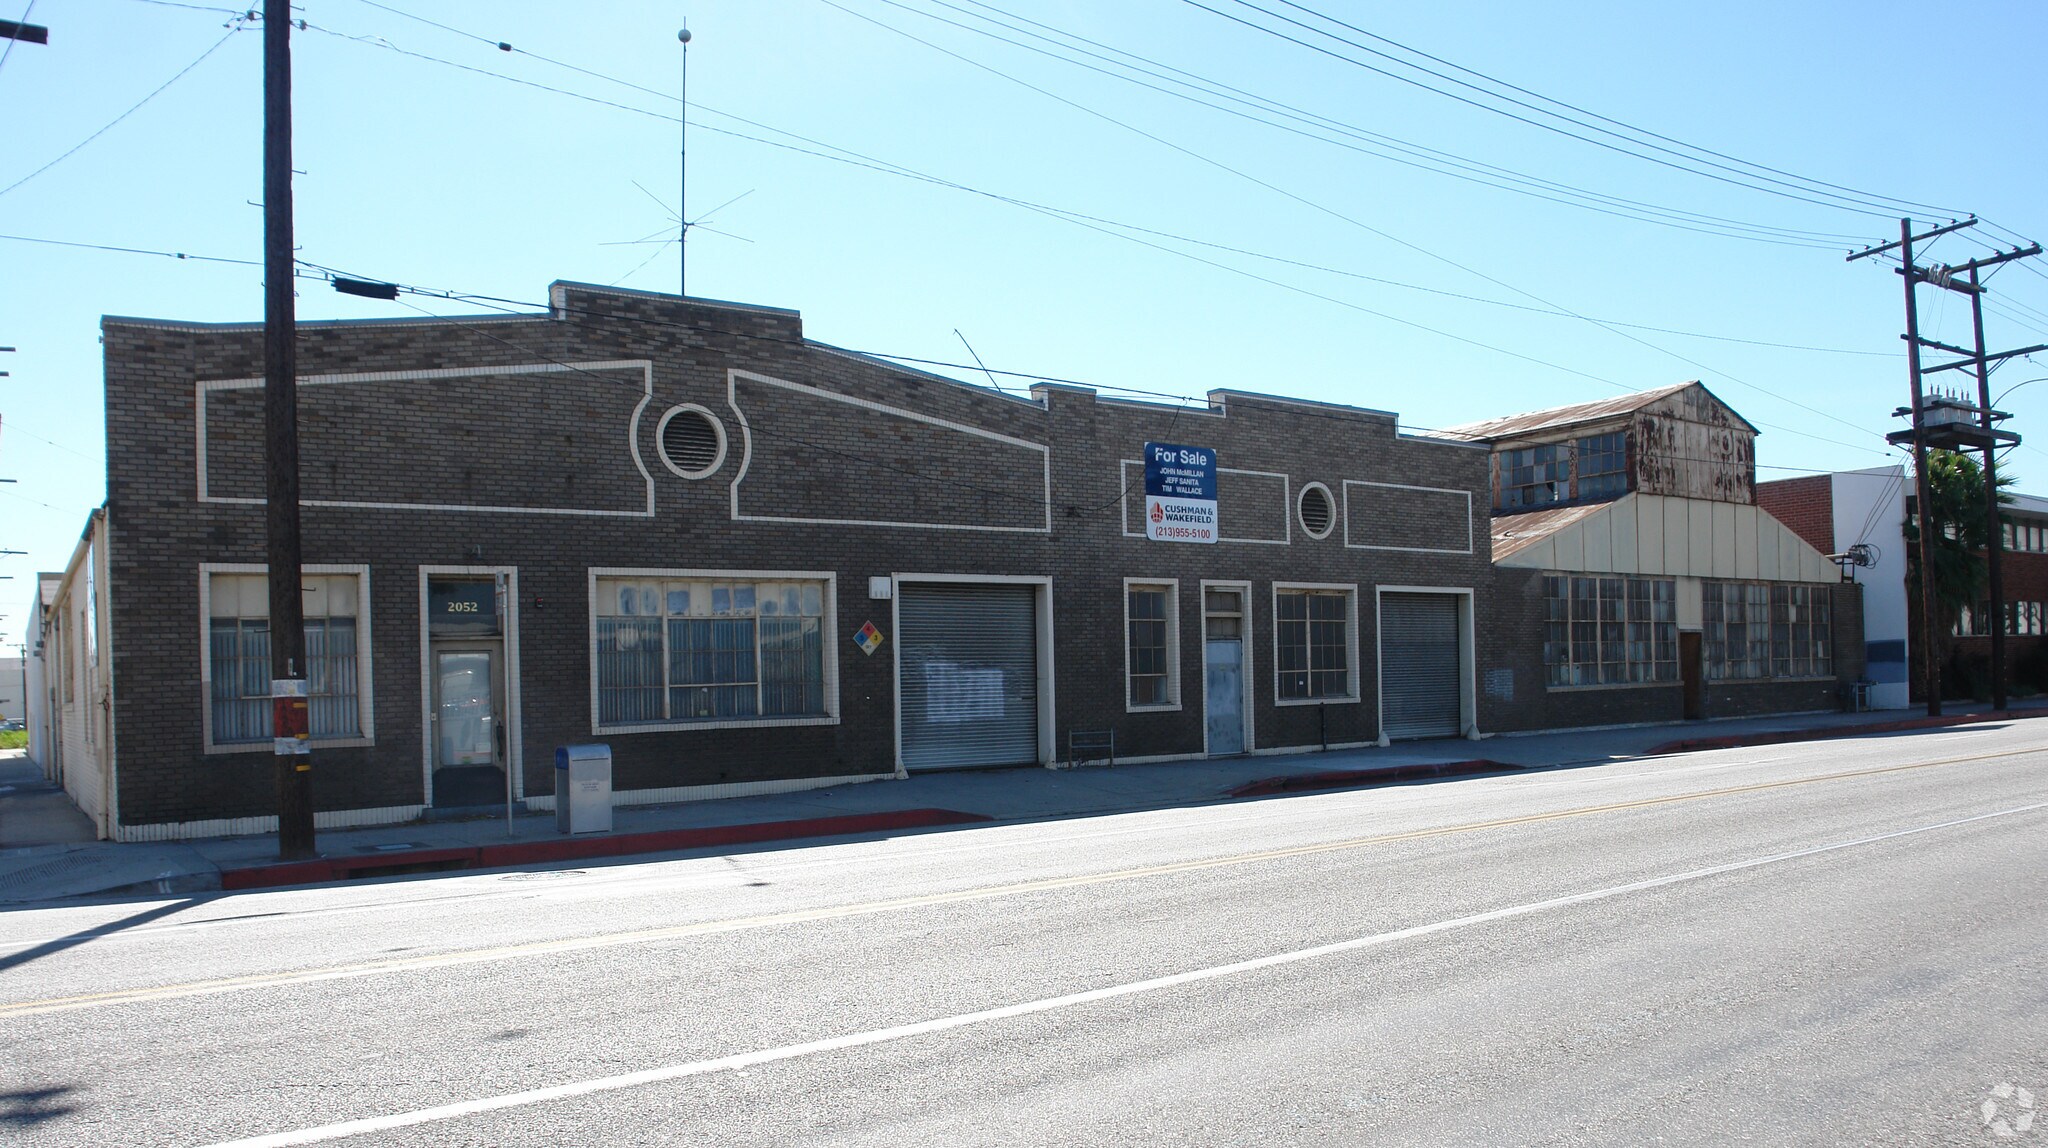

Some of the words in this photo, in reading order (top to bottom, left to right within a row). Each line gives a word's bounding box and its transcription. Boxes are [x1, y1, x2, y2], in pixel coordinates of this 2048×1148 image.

[1155, 447, 1177, 463] For
[1180, 450, 1207, 466] Sale
[1160, 467, 1176, 475] JOHN
[1176, 468, 1204, 478] McMILLAN
[1165, 476, 1179, 484] JEFF
[1162, 485, 1173, 493] TIM
[1175, 486, 1203, 495] WALLACE
[1165, 504, 1207, 515] CUSHMAN
[1207, 508, 1214, 516] &
[1165, 514, 1212, 523] WAKEFIELD
[1155, 525, 1211, 539] (213)955-5100
[447, 601, 478, 612] 2052
